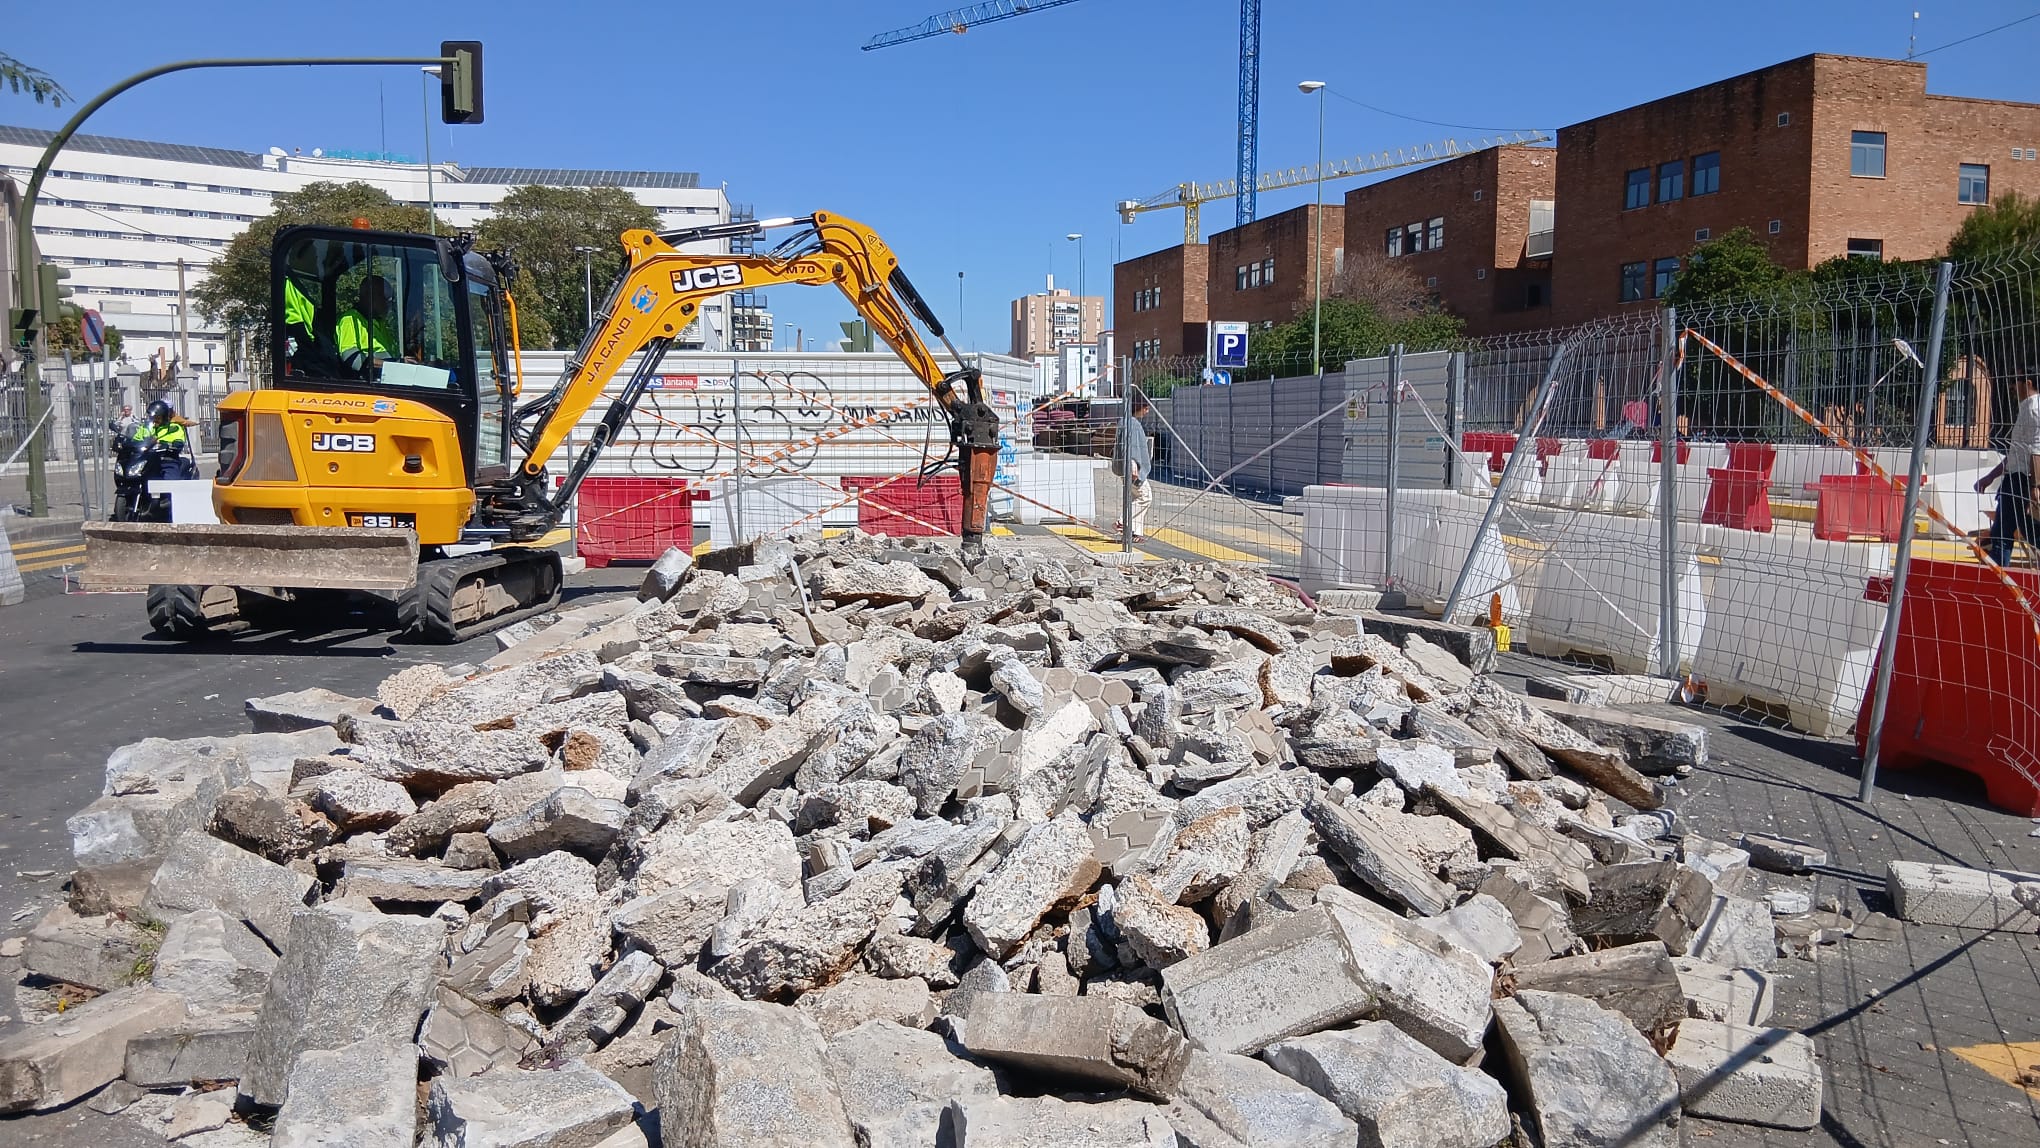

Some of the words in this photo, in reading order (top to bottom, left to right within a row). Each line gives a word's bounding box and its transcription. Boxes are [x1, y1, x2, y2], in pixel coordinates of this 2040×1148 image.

[674, 264, 742, 292] JCB
[786, 265, 815, 274] M70
[1223, 335, 1239, 356] P
[312, 434, 375, 451] JCB
[363, 515, 393, 528] 35
